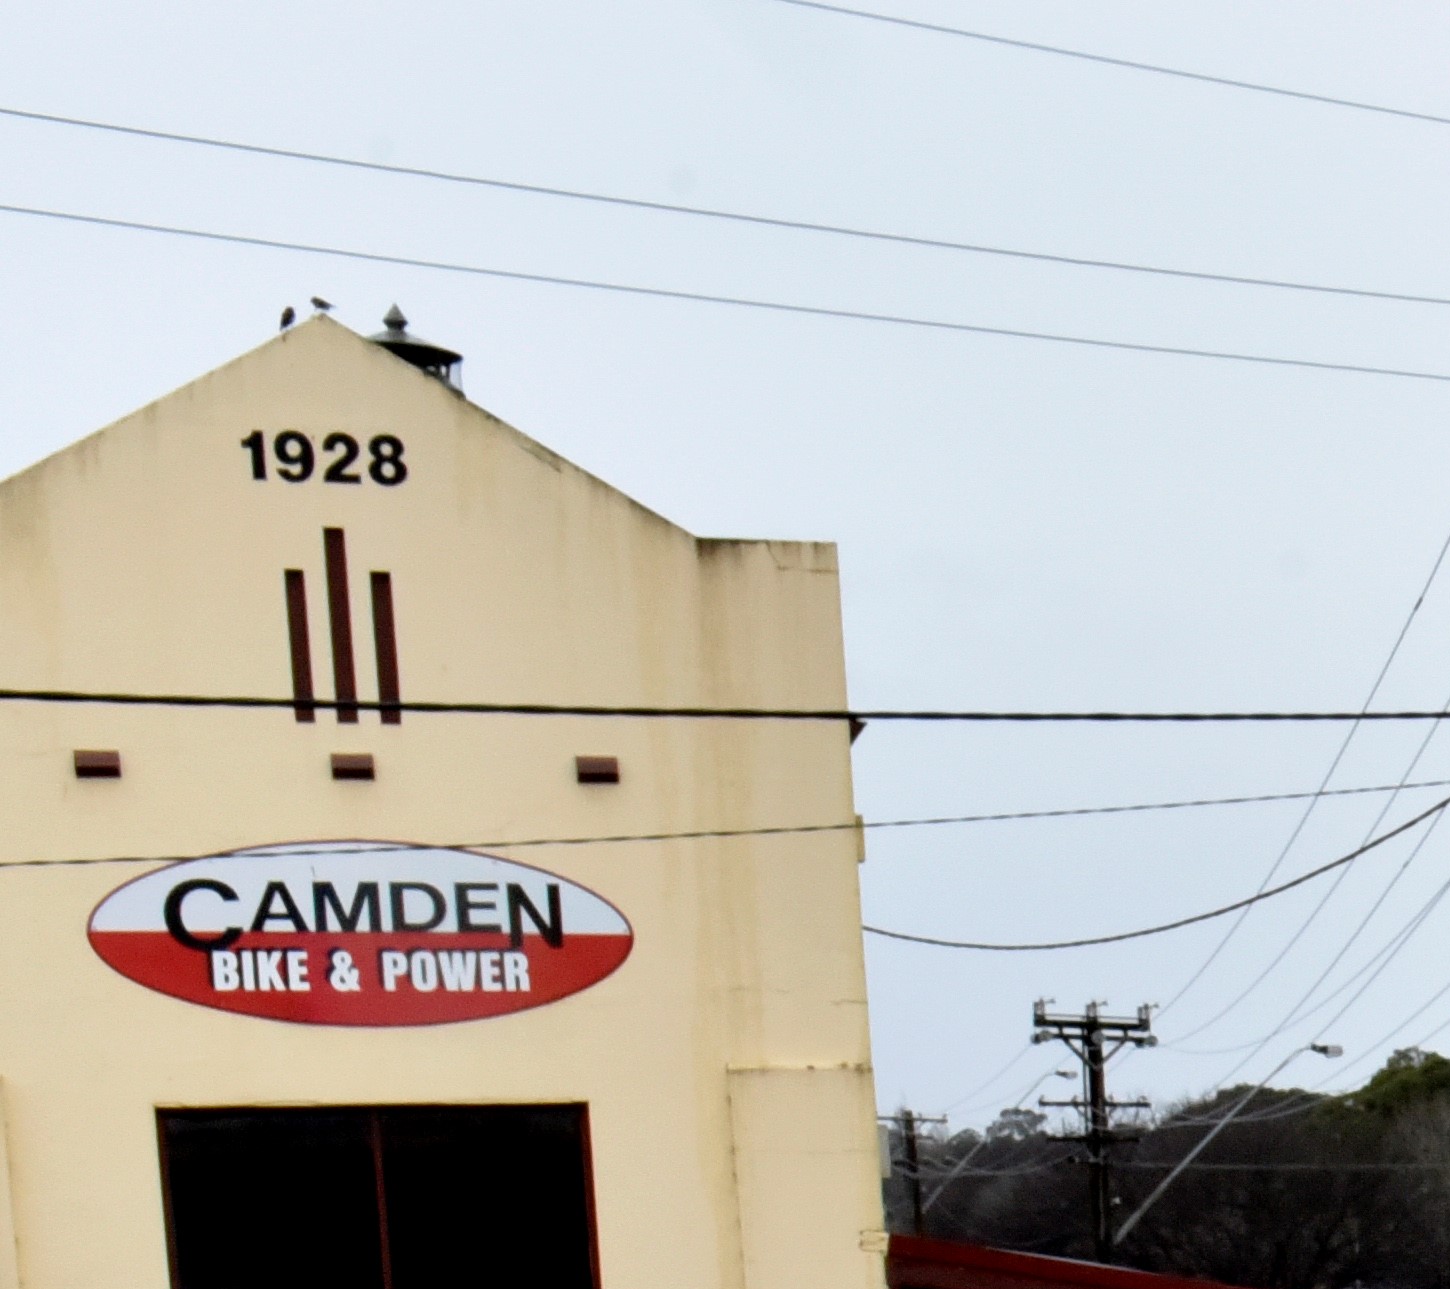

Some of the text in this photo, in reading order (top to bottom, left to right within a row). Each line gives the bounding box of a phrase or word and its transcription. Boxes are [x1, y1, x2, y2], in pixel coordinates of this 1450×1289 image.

[240, 429, 408, 487] 1928
[163, 878, 564, 950] CAMDEN
[212, 949, 531, 992] BIKE & POWER
